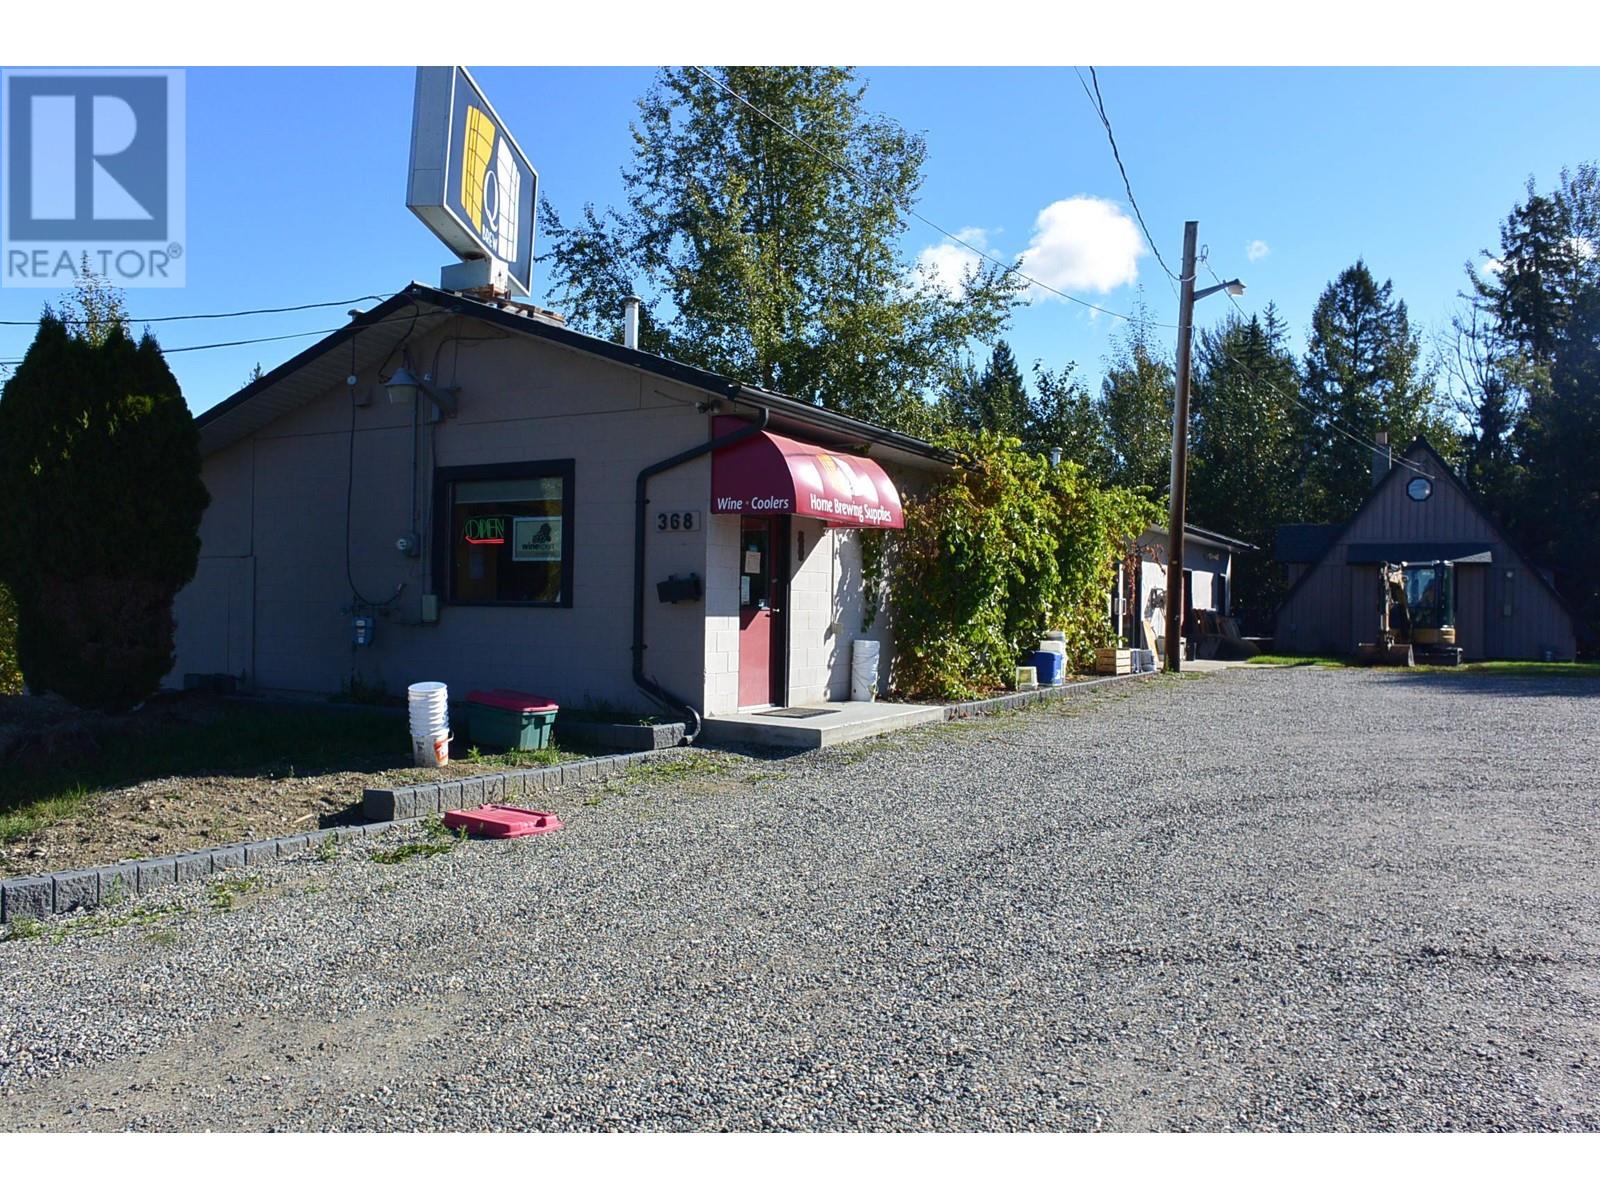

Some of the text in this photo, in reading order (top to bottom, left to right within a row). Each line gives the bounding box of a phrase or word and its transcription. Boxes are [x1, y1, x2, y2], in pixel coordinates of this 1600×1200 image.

[483, 170, 498, 233] Q
[482, 223, 498, 252] BREW
[717, 496, 789, 511] Wine Coolers
[809, 493, 892, 524] Home Brewing Supplies
[464, 518, 505, 538] OPEN
[657, 512, 694, 530] 368
